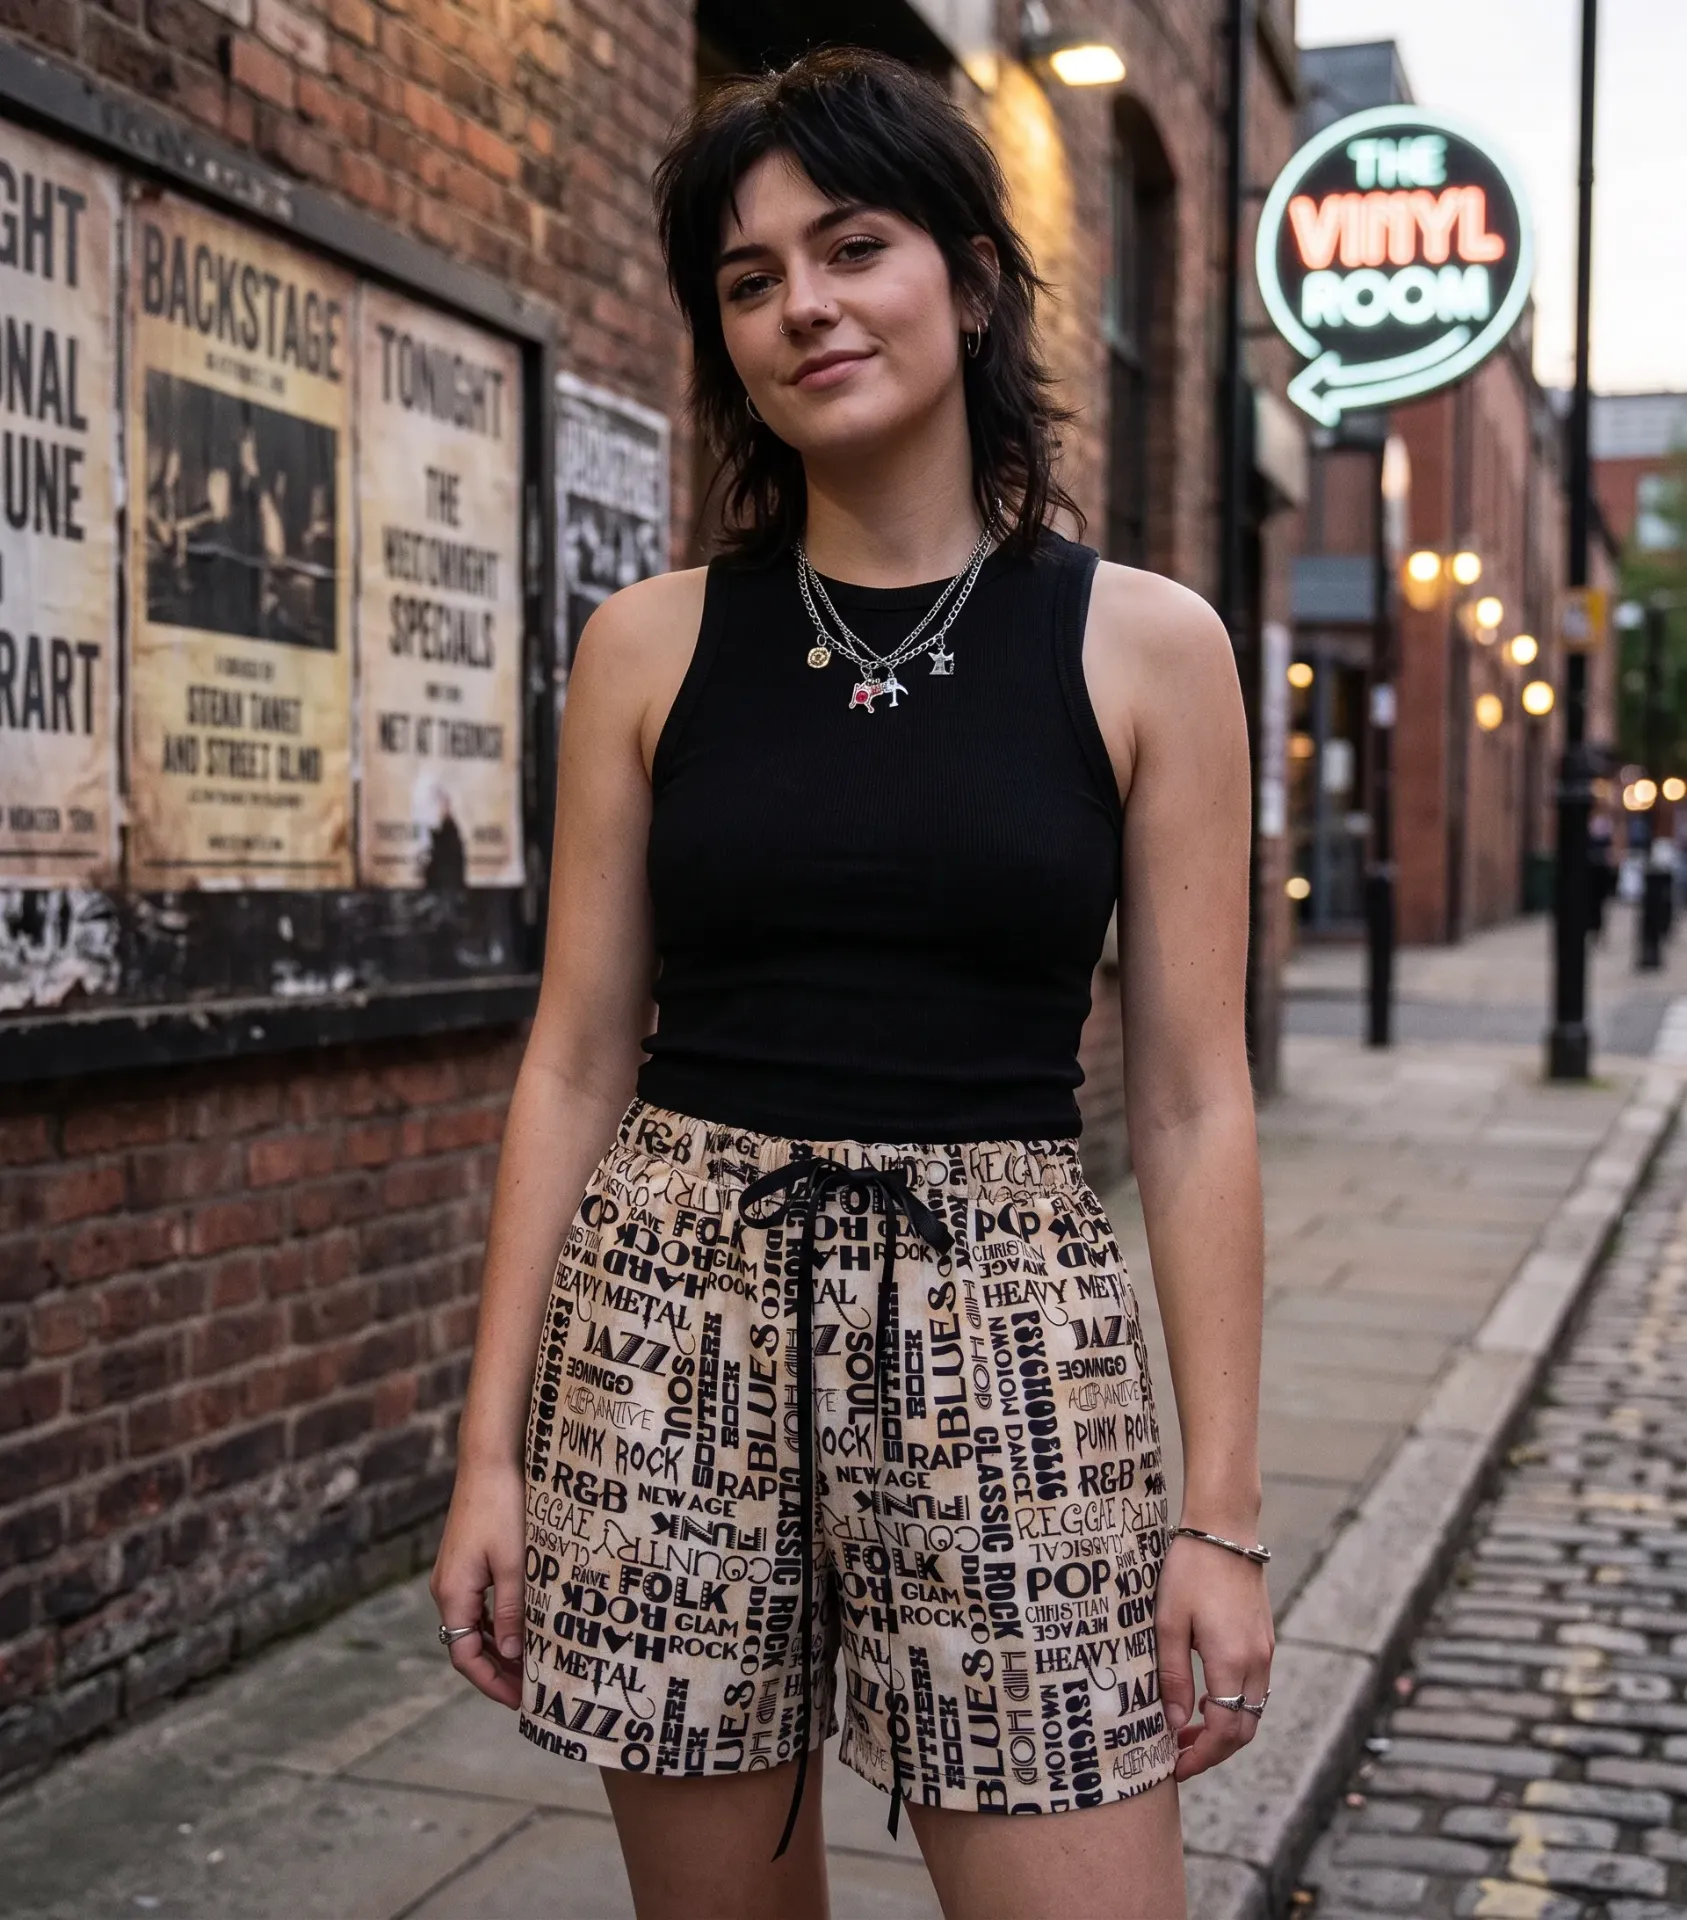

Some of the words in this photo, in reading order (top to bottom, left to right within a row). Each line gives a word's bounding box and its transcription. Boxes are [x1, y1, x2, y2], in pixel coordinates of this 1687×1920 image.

[1346, 134, 1448, 189] THE
[0, 157, 87, 289] GHT
[1288, 185, 1505, 270] VINYL
[143, 222, 343, 386] BACKSTAGE
[1301, 264, 1490, 329] ROOM
[0, 314, 87, 433] NAL
[3, 430, 85, 543] UNE
[601, 1280, 696, 1356] METAL
[982, 1278, 1069, 1327] HEAVY
[582, 1321, 672, 1377] JAZZ
[928, 1280, 972, 1440] BLUES
[660, 1354, 697, 1447] SOUL
[746, 1323, 781, 1474] BLUES
[845, 1330, 879, 1426] SOUL
[559, 1416, 607, 1468] PUNK
[615, 1434, 685, 1486] ROCK
[907, 1441, 973, 1472] RAP
[1073, 1413, 1117, 1459] PUNK
[551, 1460, 629, 1514] R&B
[637, 1482, 687, 1509] NEW
[687, 1496, 738, 1519] AGE
[715, 1470, 778, 1502] RAP
[835, 1465, 883, 1485] NEW
[884, 1468, 931, 1489] AGE
[973, 1426, 1014, 1553] CLASSIC
[1078, 1457, 1135, 1498] R&B
[618, 1563, 731, 1615] FOLK
[841, 1541, 945, 1583] FOLK
[1026, 1559, 1111, 1602] POP
[899, 1605, 968, 1630] ROCK
[901, 1582, 961, 1606] GLAM
[983, 1561, 1024, 1641] ROCK
[668, 1633, 739, 1661] ROCK
[674, 1612, 739, 1638] GLAM
[553, 1643, 656, 1720] METAL
[1035, 1637, 1121, 1691] HEAVY
[531, 1681, 624, 1743] JAZZ
